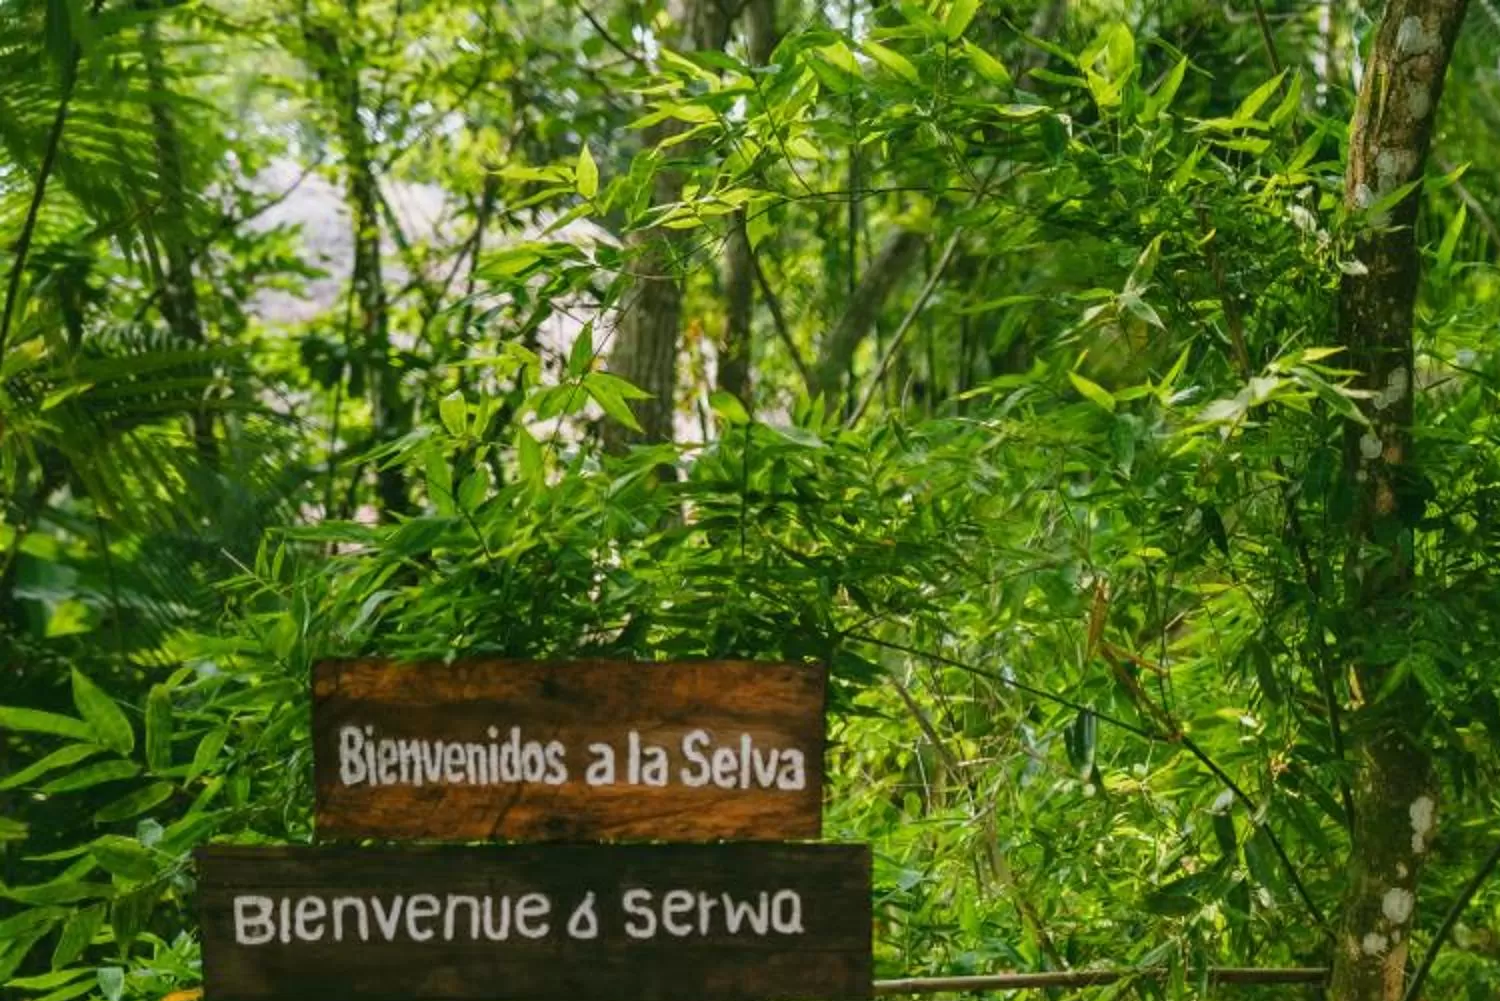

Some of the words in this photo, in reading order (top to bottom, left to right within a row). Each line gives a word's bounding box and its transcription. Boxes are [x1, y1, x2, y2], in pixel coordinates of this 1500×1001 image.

[339, 725, 569, 787] Bienvenidos
[585, 742, 616, 787] a
[627, 730, 669, 788] la
[679, 729, 807, 791] Selva
